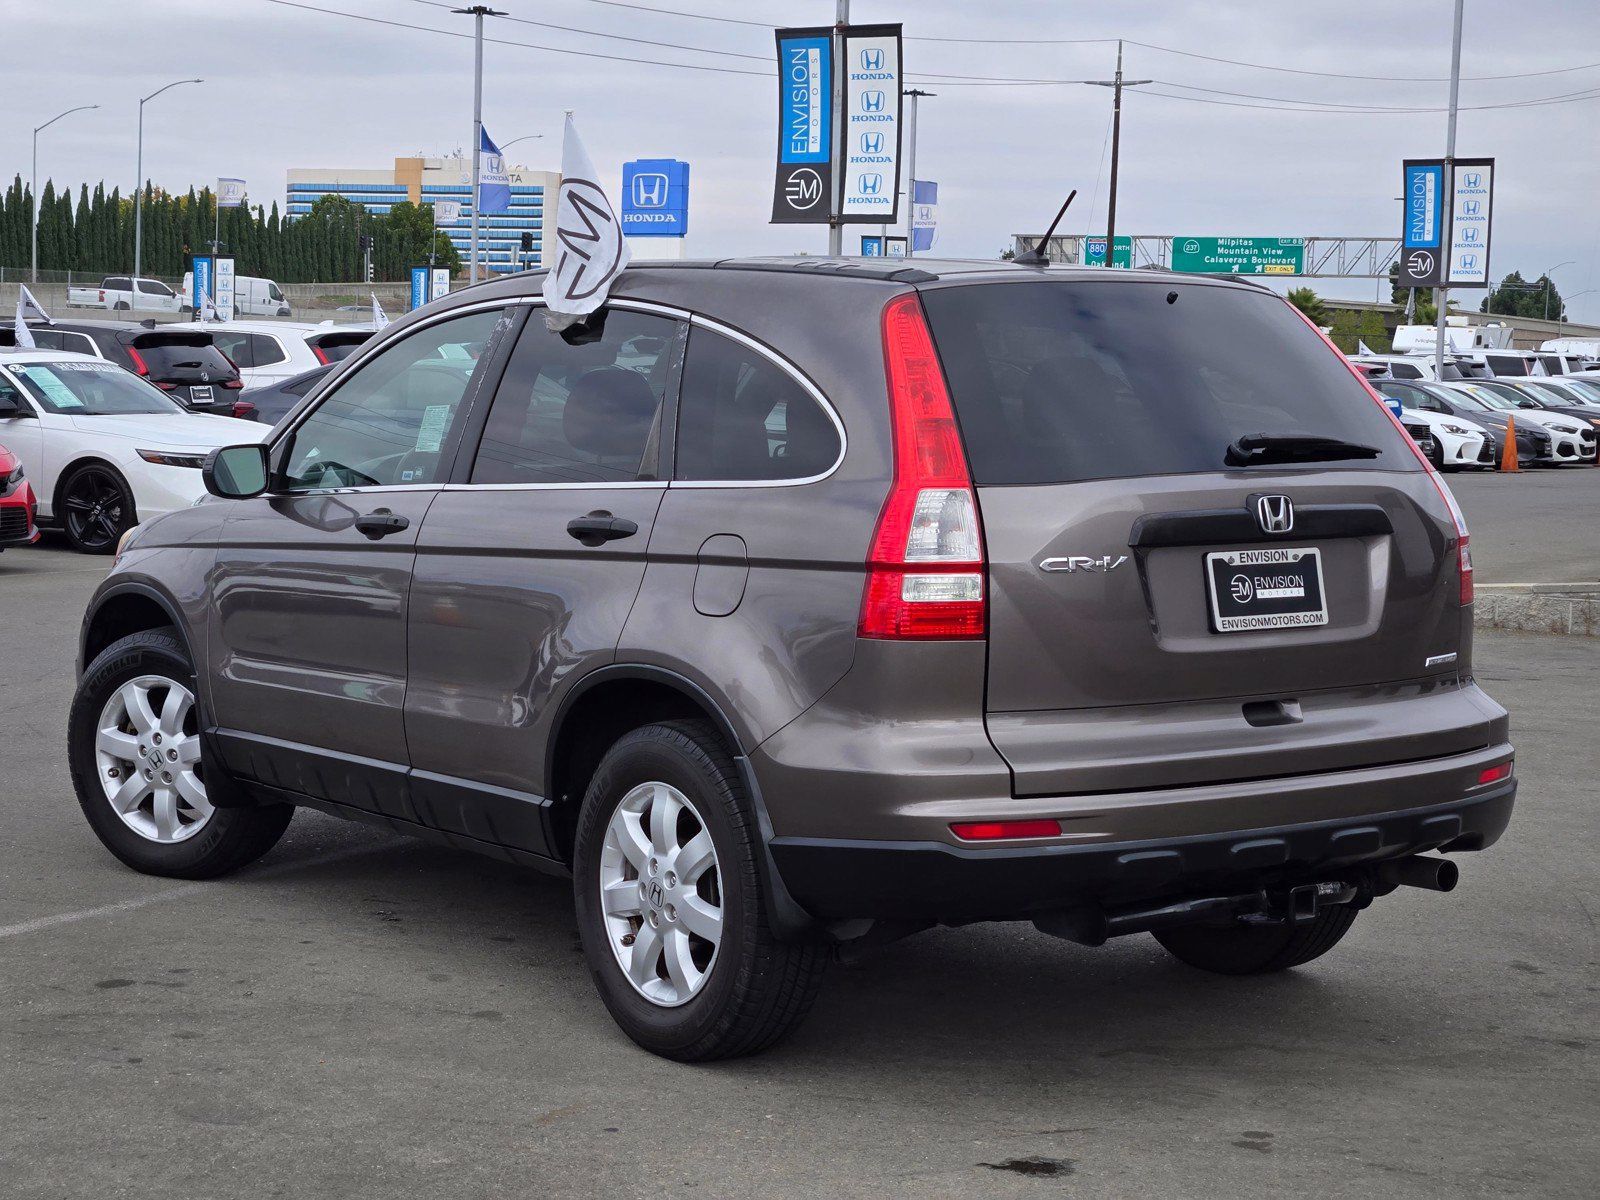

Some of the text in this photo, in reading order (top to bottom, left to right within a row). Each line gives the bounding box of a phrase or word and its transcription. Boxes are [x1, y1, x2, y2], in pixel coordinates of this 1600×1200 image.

[791, 49, 808, 154] ENVISION
[811, 58, 819, 144] MOTORS
[1411, 172, 1426, 241] ENVISION
[623, 213, 677, 223] HONDA
[1089, 244, 1105, 252] 880
[1217, 238, 1253, 246] Milpitas
[1217, 246, 1284, 255] Mountain View
[1251, 256, 1296, 264] Boulevard
[1239, 550, 1289, 563] ENVISION
[1039, 556, 1128, 572] CR-V
[1254, 575, 1304, 589] ENVISION
[1260, 589, 1301, 597] MOTORS
[1221, 613, 1324, 629] ENVISIONMOTORS.COM
